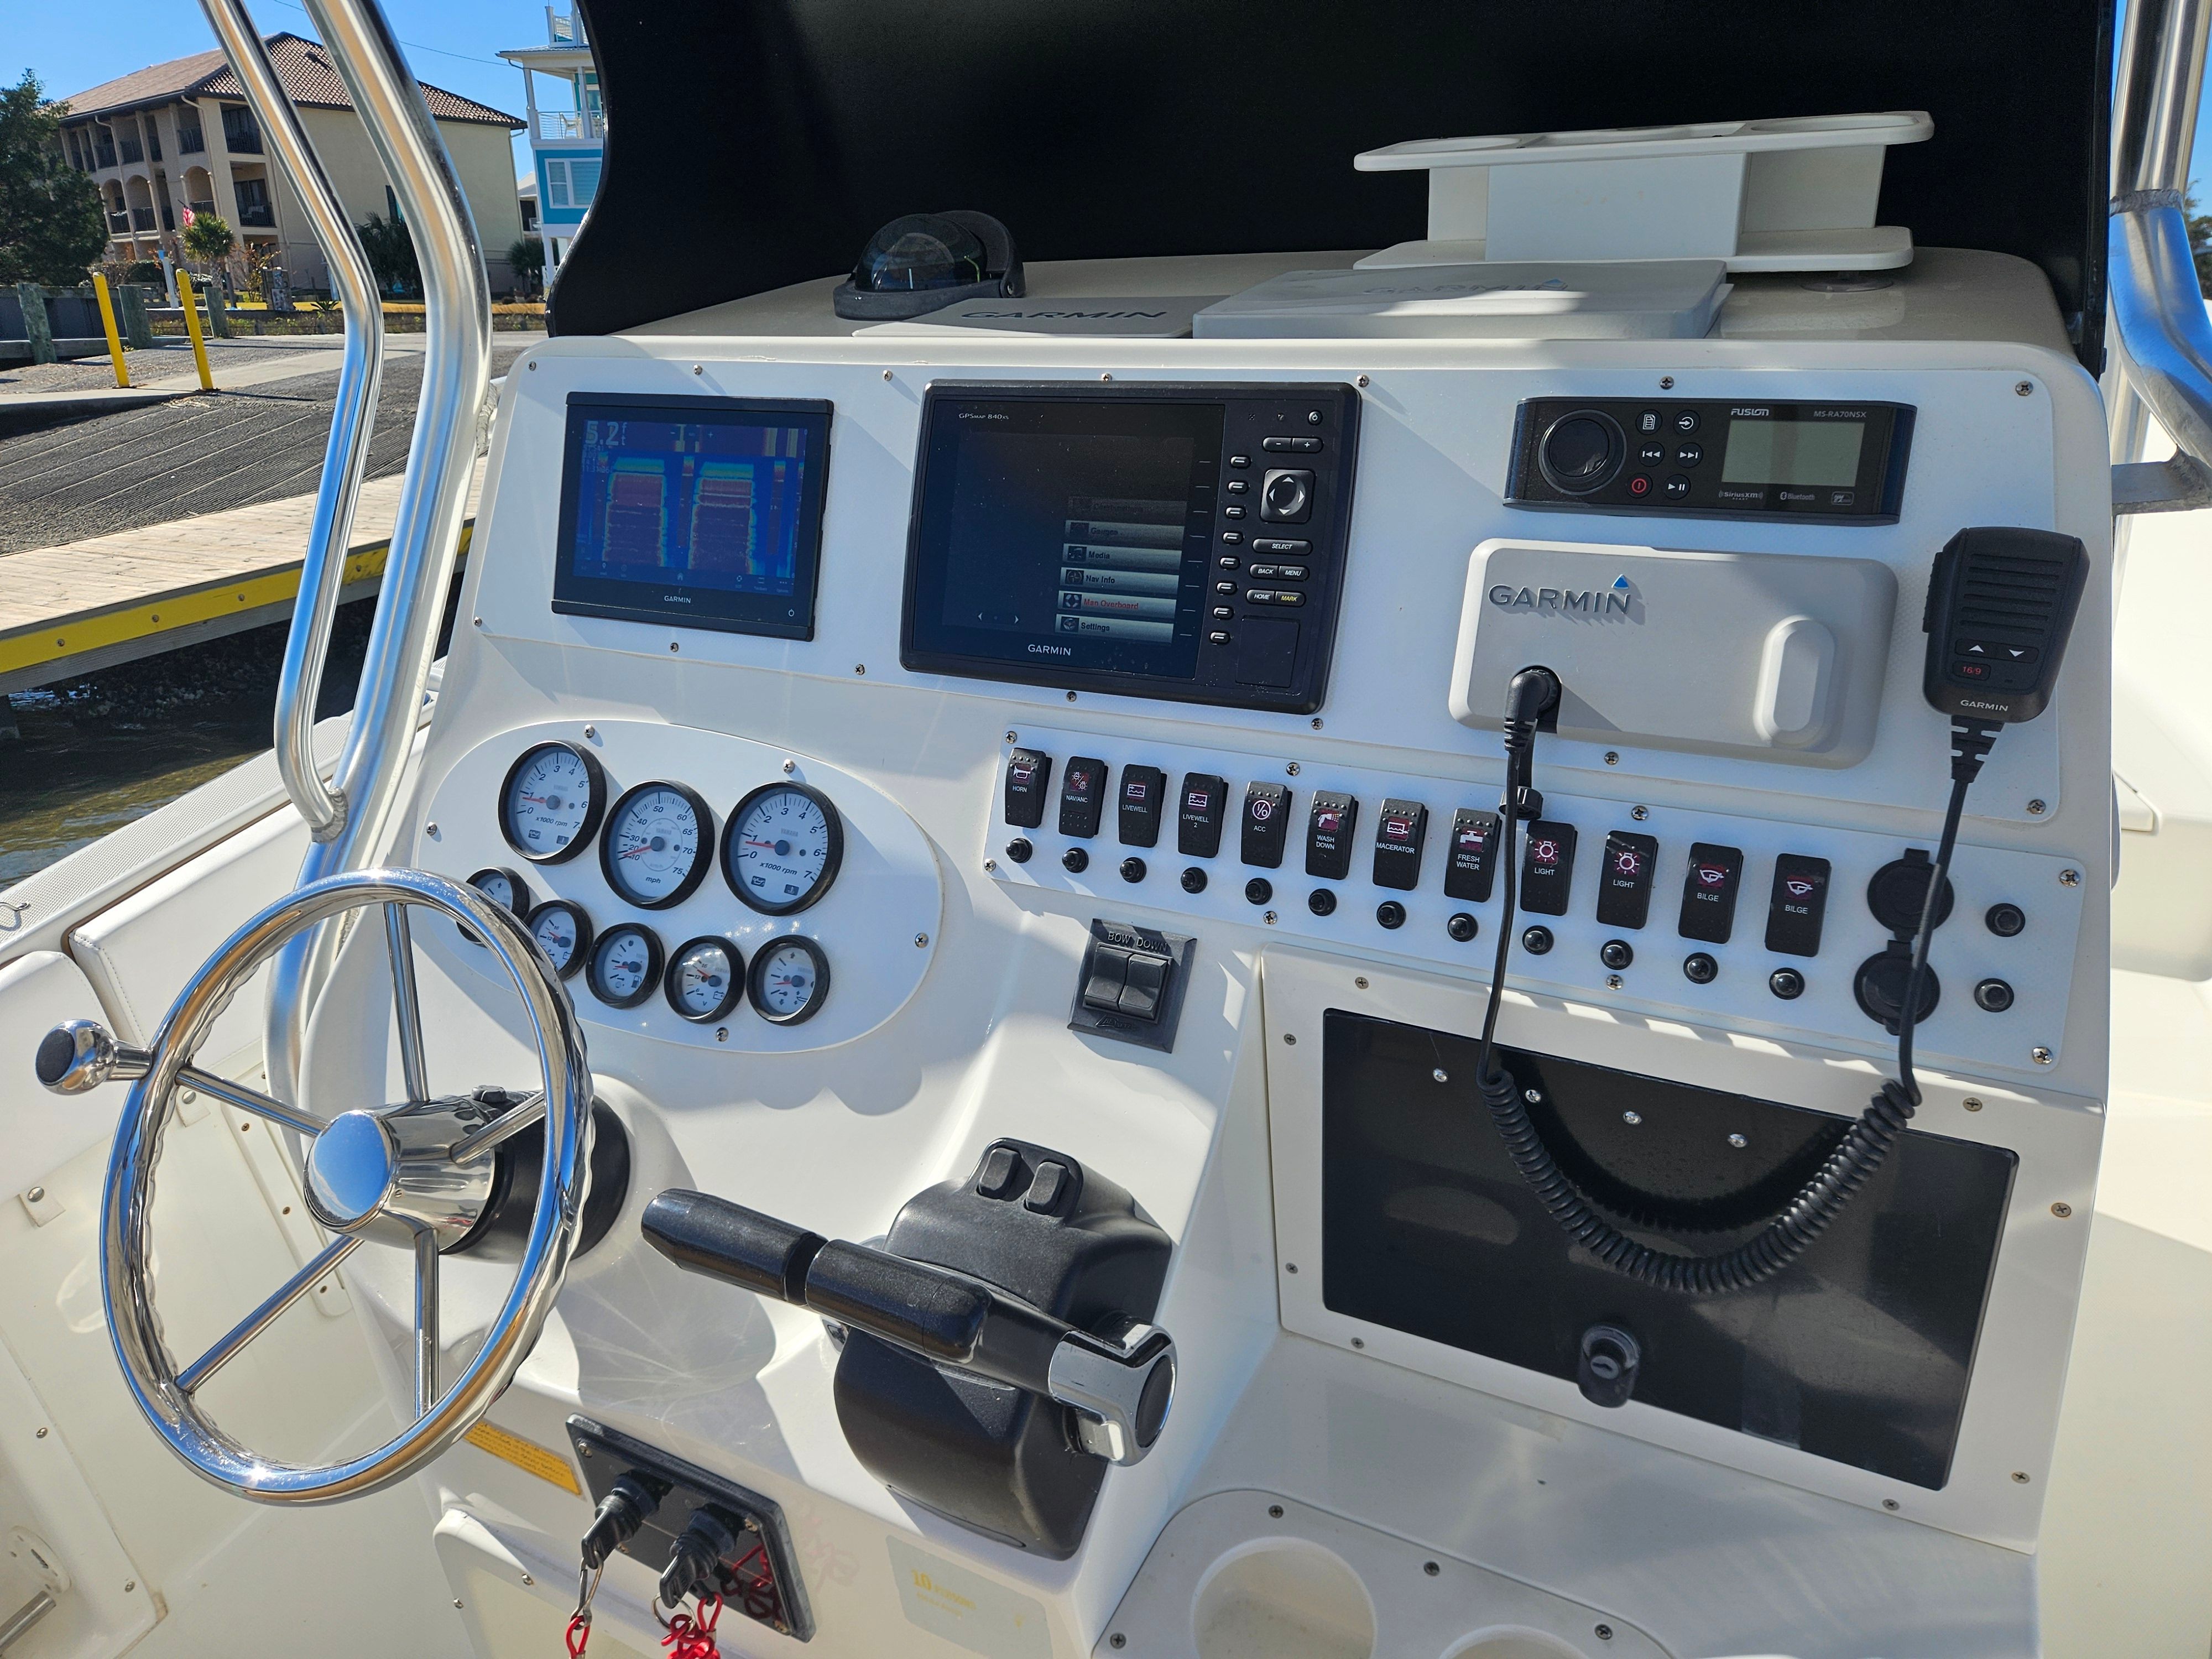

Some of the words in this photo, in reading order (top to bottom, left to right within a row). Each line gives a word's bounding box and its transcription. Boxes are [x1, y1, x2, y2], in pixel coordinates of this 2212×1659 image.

[585, 420, 619, 446] 5.2
[1088, 551, 1110, 560] Media
[664, 595, 691, 604] GARMIN
[1100, 599, 1139, 610] Overboard
[1488, 584, 1631, 615] GARMIN
[1081, 622, 1110, 632] Settings
[1027, 643, 1072, 657] GARMIN
[1960, 700, 2008, 712] GARMIN
[1066, 794, 1088, 804] NAV/ANC
[1122, 804, 1147, 813] LIVEWELL
[1182, 813, 1209, 823] LIVEWELL
[1317, 834, 1335, 843] WASH
[1316, 841, 1335, 850] DOWN
[1376, 842, 1415, 854] MACERATOR
[813, 848, 822, 857] 6
[1457, 853, 1480, 863] FRESH
[759, 862, 781, 871] x1000
[1456, 861, 1480, 870] WATER
[672, 867, 682, 875] 75
[1533, 867, 1555, 876] LIGHT
[1613, 879, 1635, 889] LIGHT
[1697, 893, 1719, 902] BILGE
[1785, 905, 1808, 915] BILGE
[1108, 931, 1132, 945] BOW
[1136, 937, 1167, 952] DOWN
